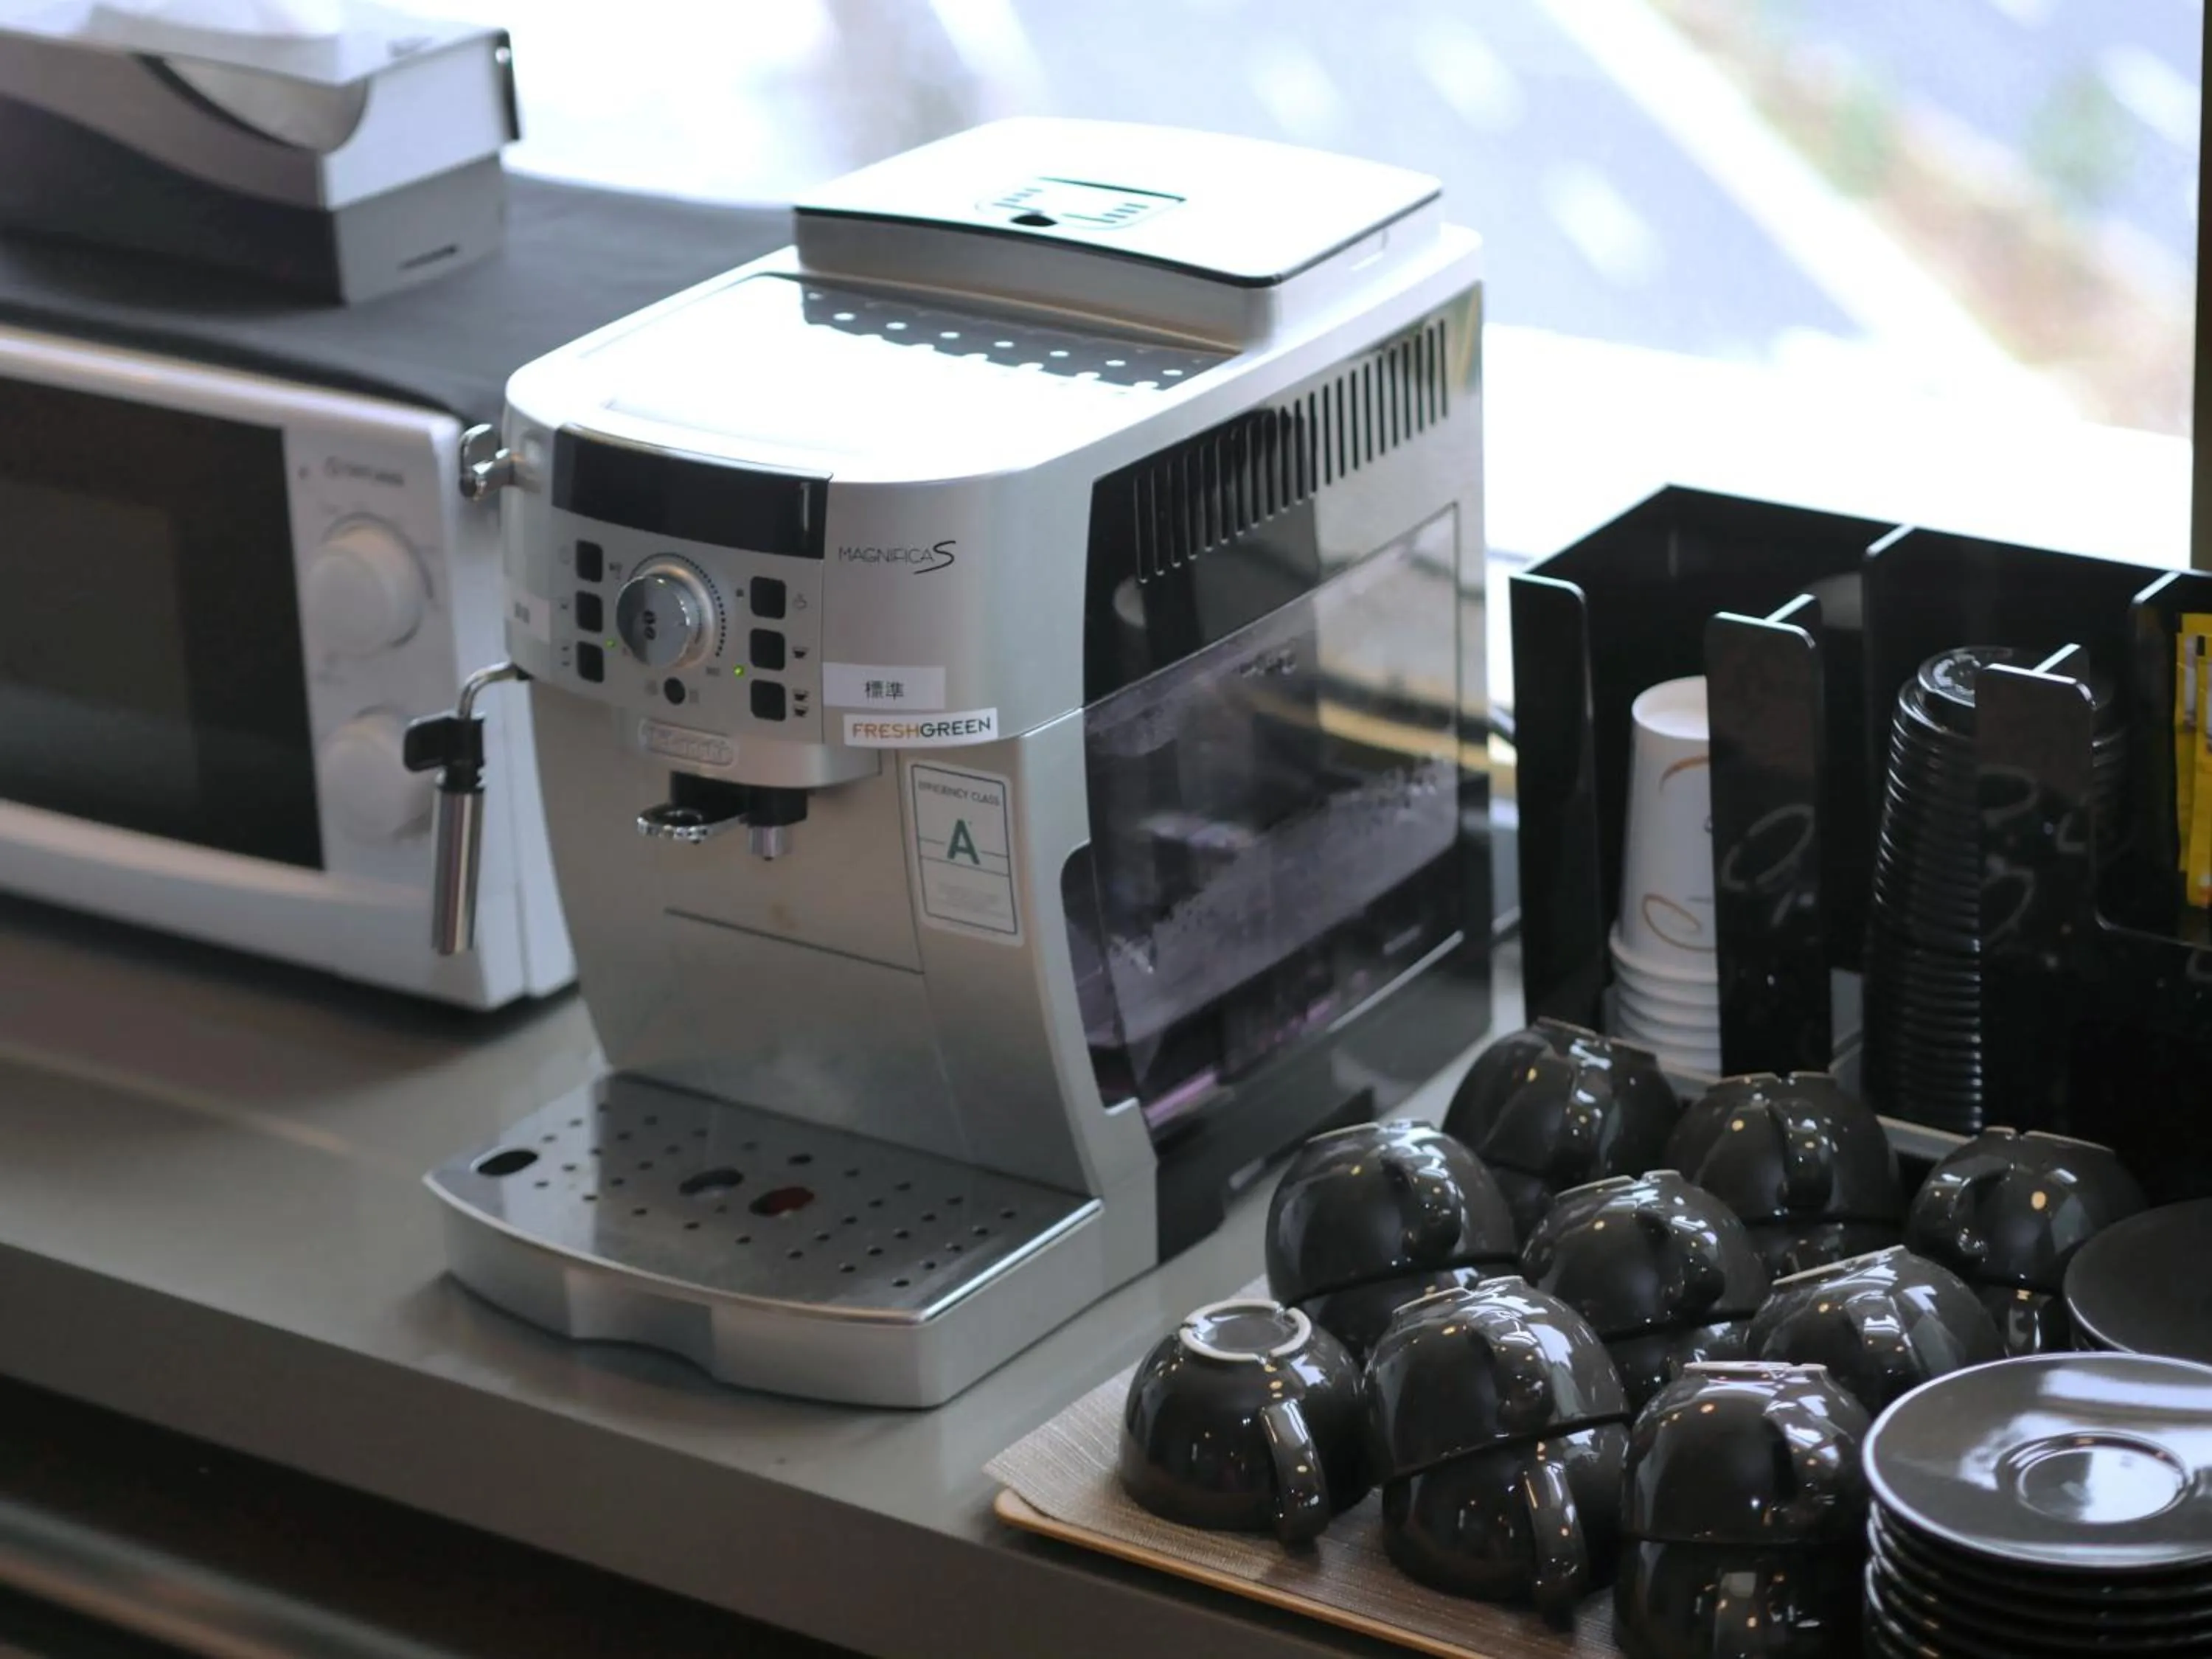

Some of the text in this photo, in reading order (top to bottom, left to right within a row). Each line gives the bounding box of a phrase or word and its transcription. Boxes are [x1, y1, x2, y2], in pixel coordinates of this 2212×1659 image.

[865, 681, 905, 700] 標準
[971, 790, 1000, 807] CLASS
[947, 818, 981, 865] A
